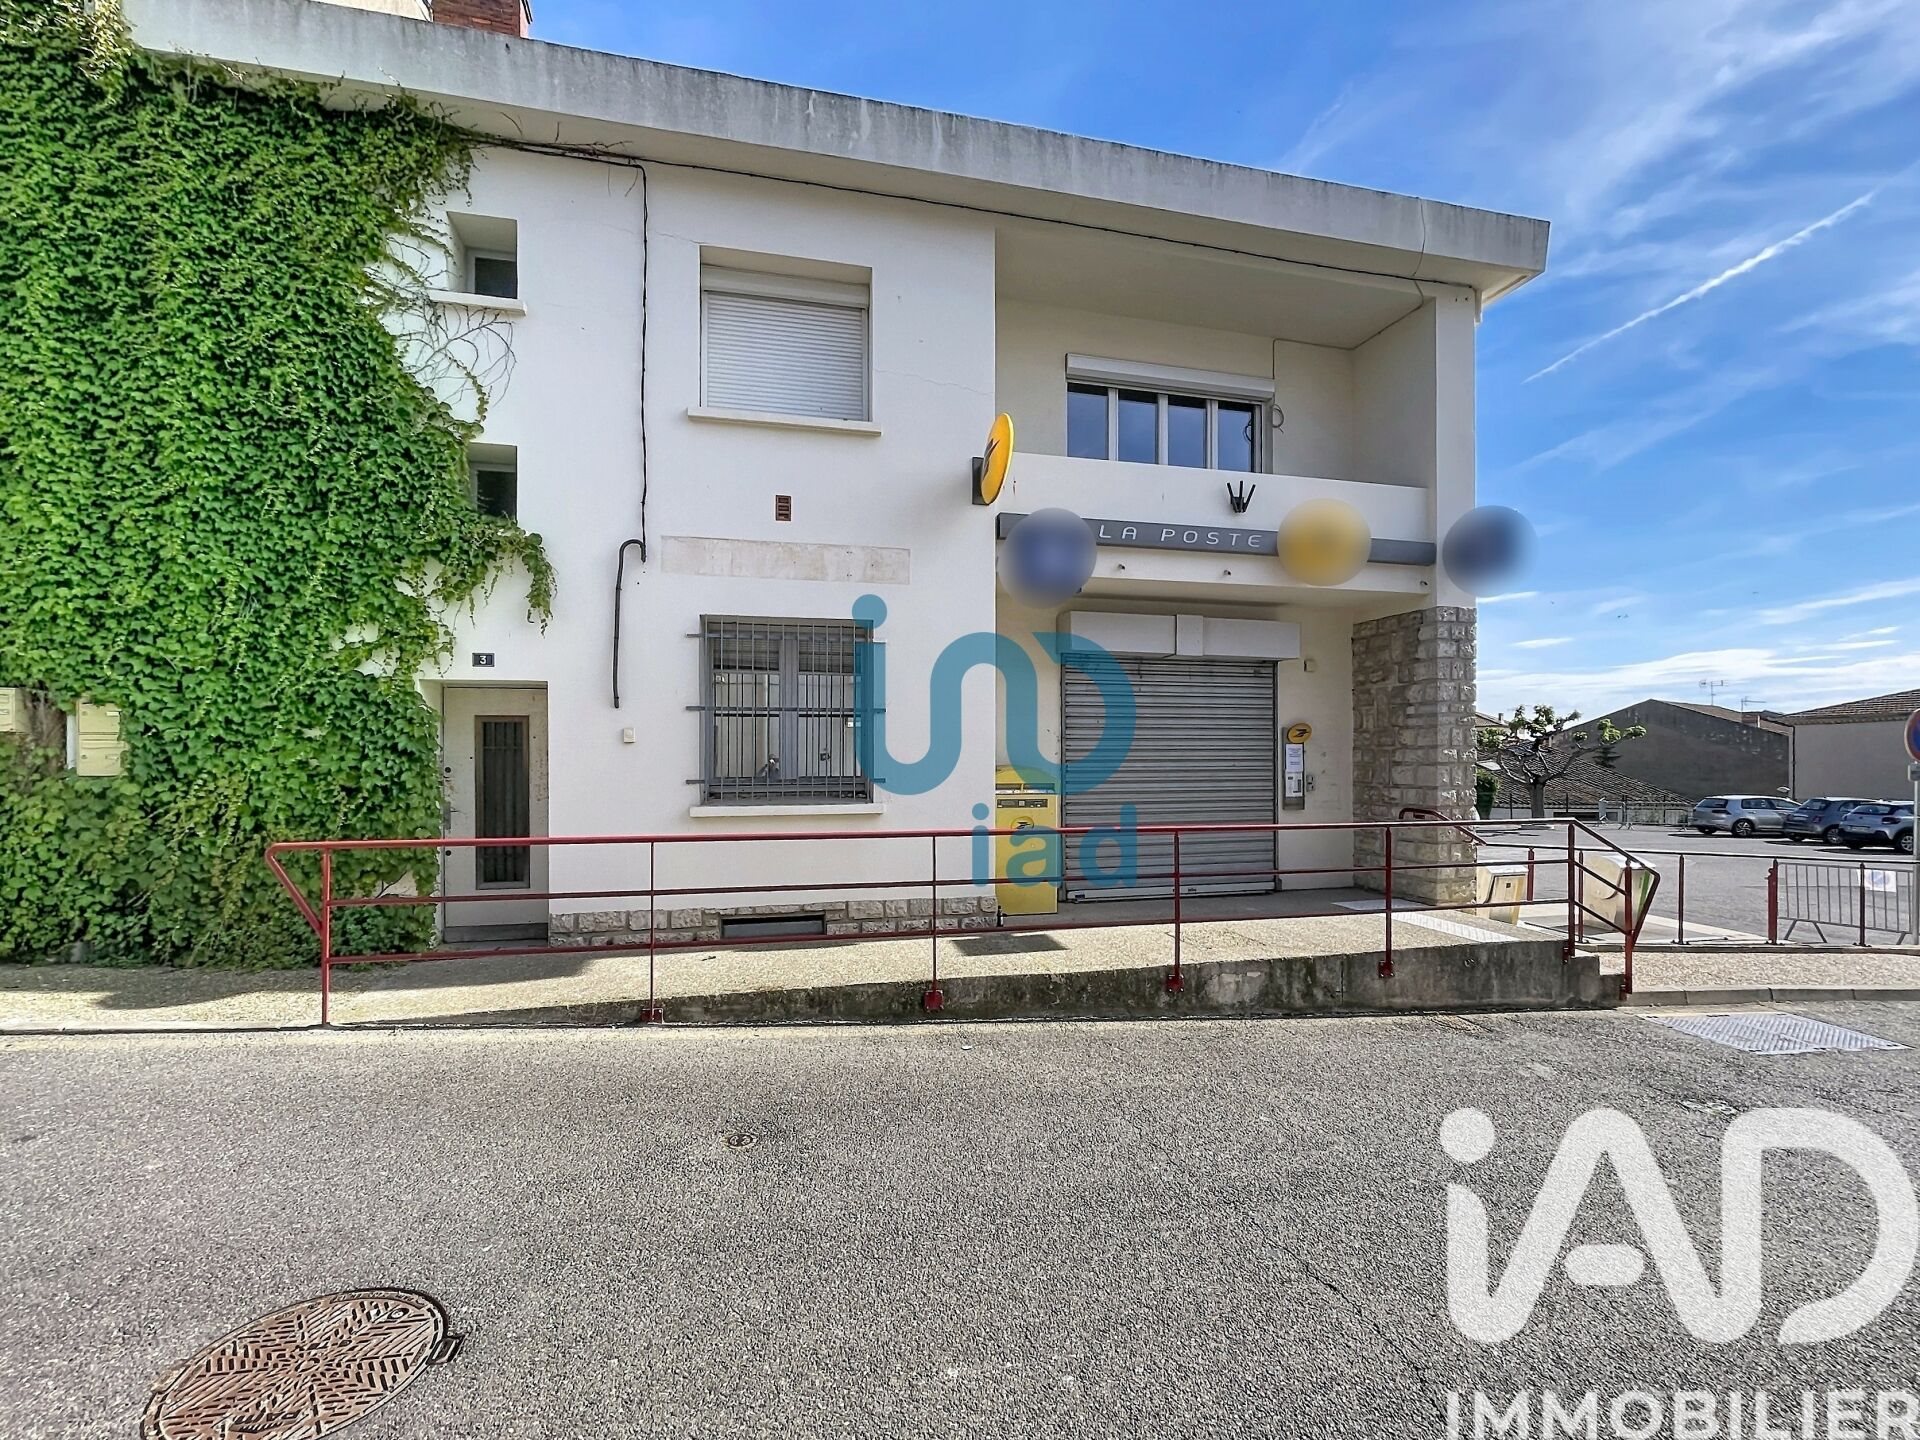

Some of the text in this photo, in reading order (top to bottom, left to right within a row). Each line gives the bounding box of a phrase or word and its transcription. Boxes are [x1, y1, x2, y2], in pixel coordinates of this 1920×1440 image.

[1099, 524, 1263, 548] LA POSTE
[479, 655, 488, 665] 3
